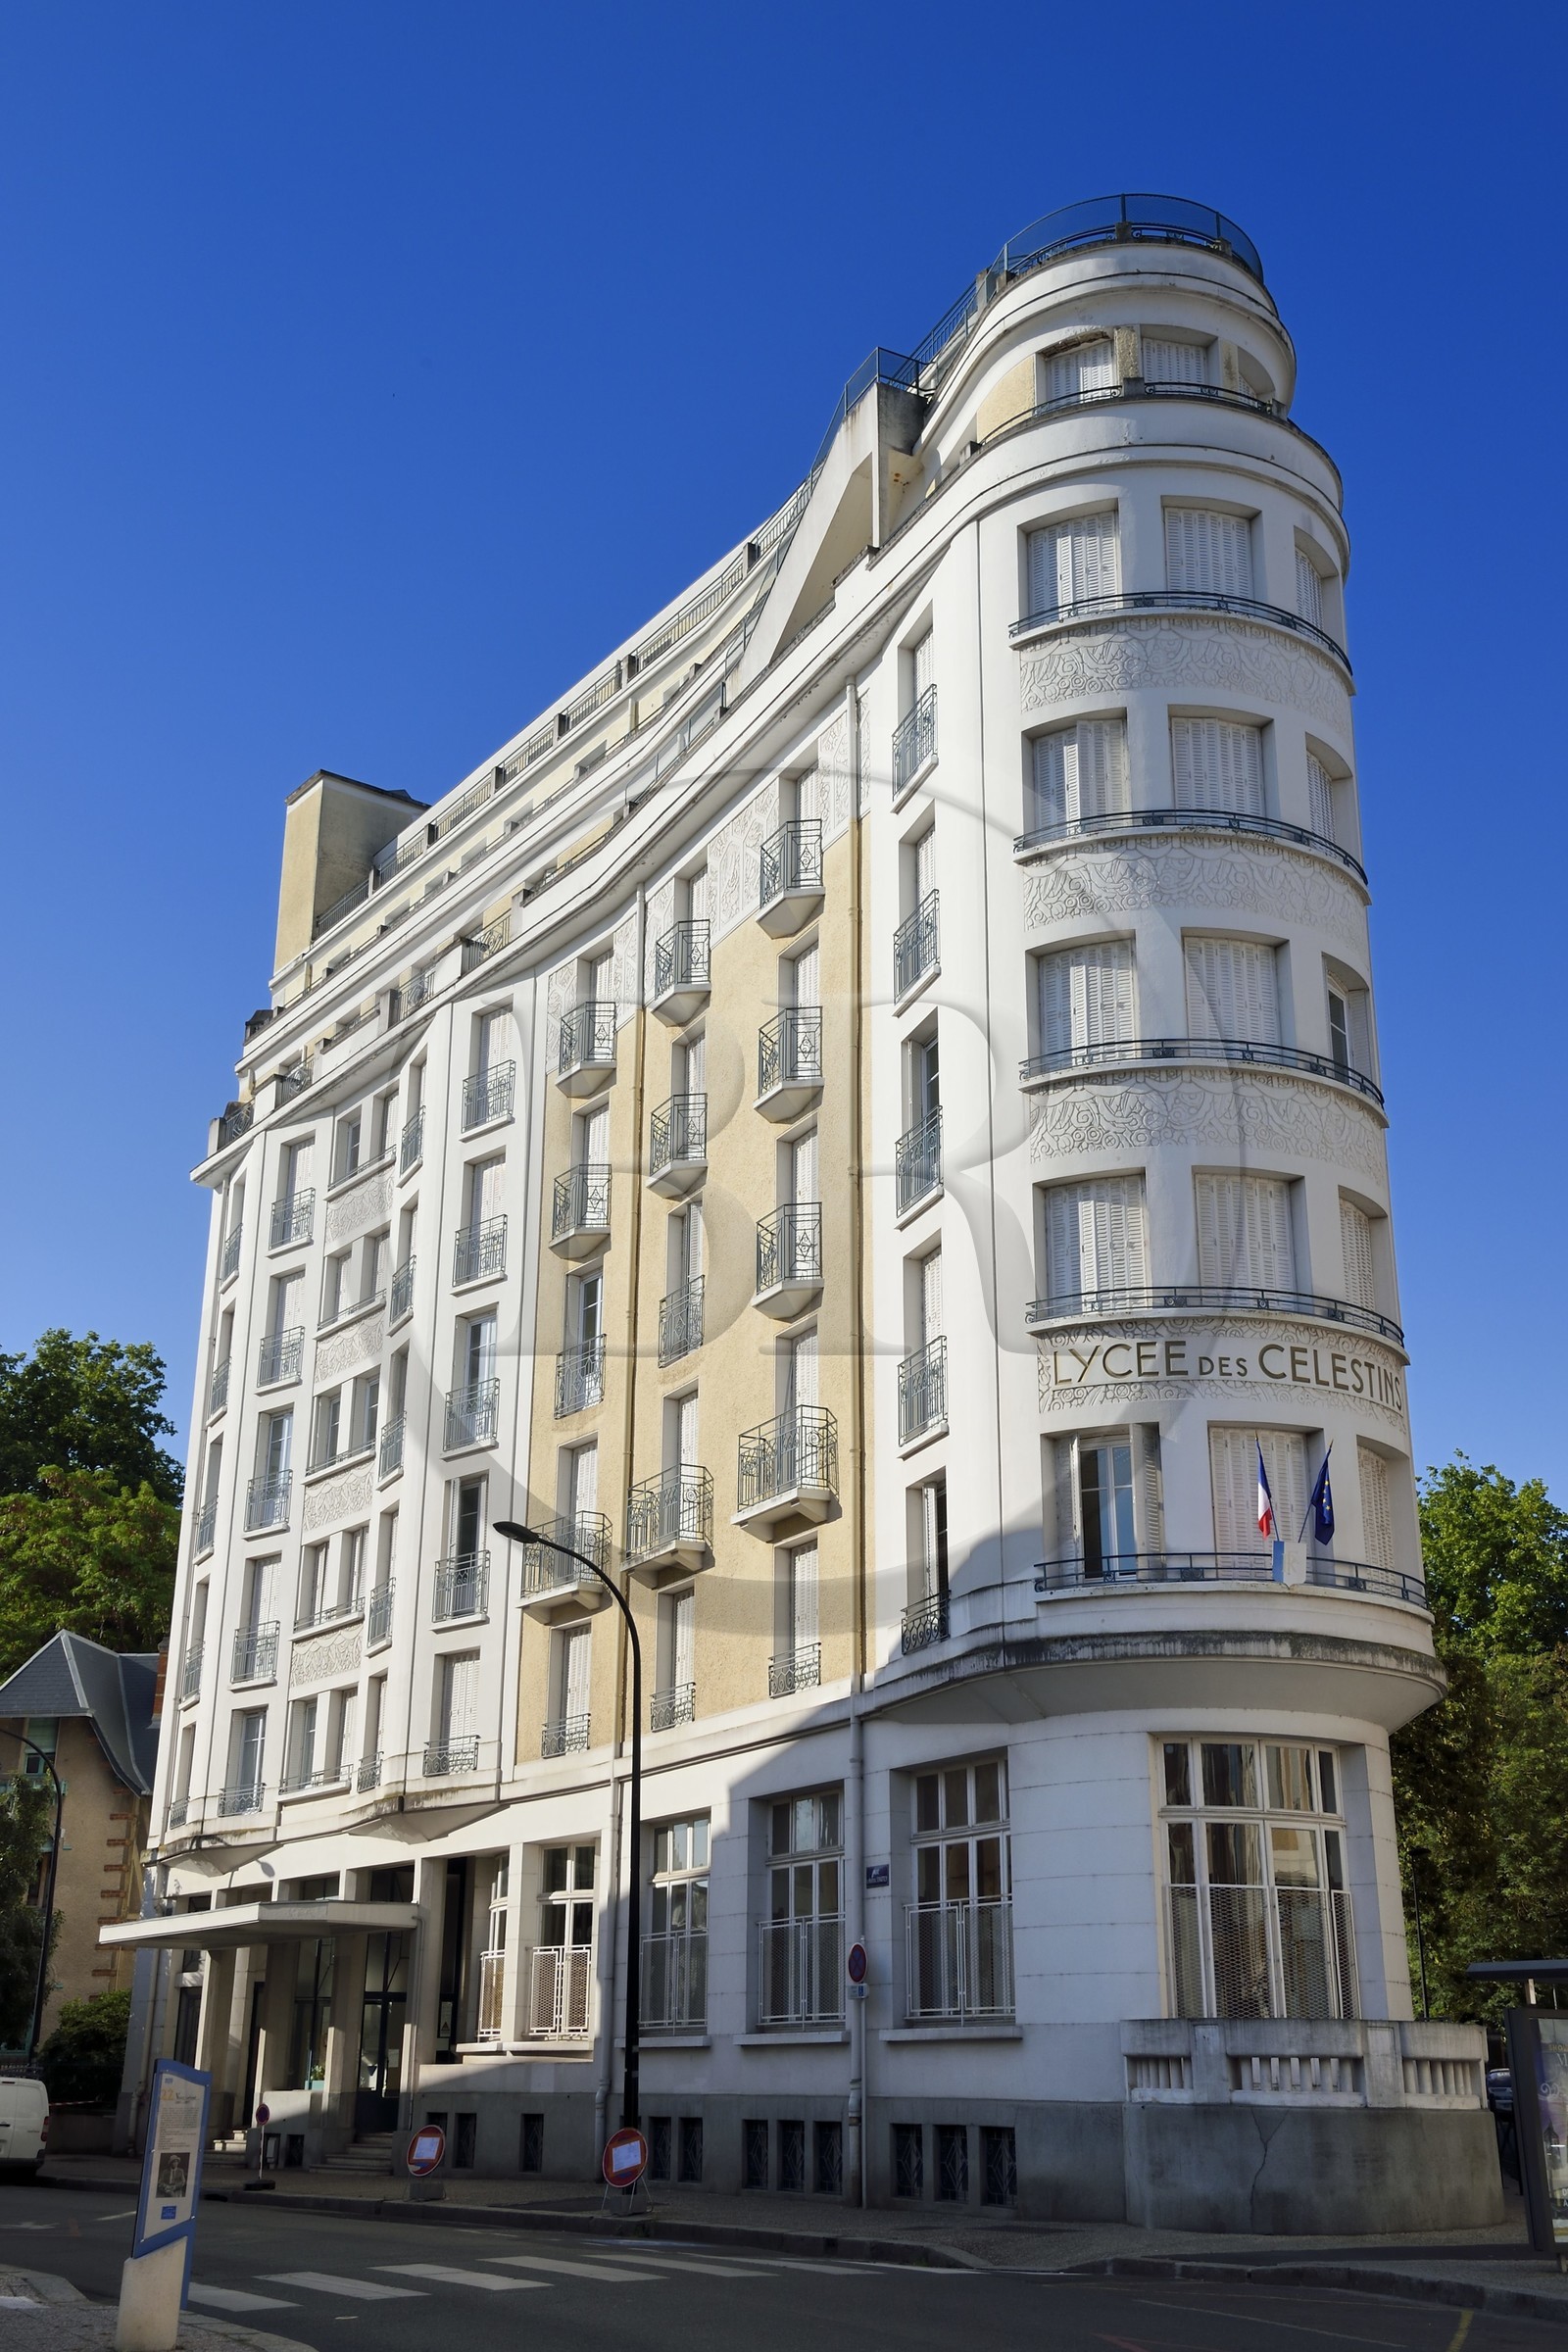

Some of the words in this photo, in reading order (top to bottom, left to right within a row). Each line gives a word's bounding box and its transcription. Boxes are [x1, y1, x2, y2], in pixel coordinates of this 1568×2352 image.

[1053, 1340, 1189, 1385] LYCEE
[1198, 1355, 1250, 1377] DES
[1257, 1344, 1403, 1412] CELESTINS
